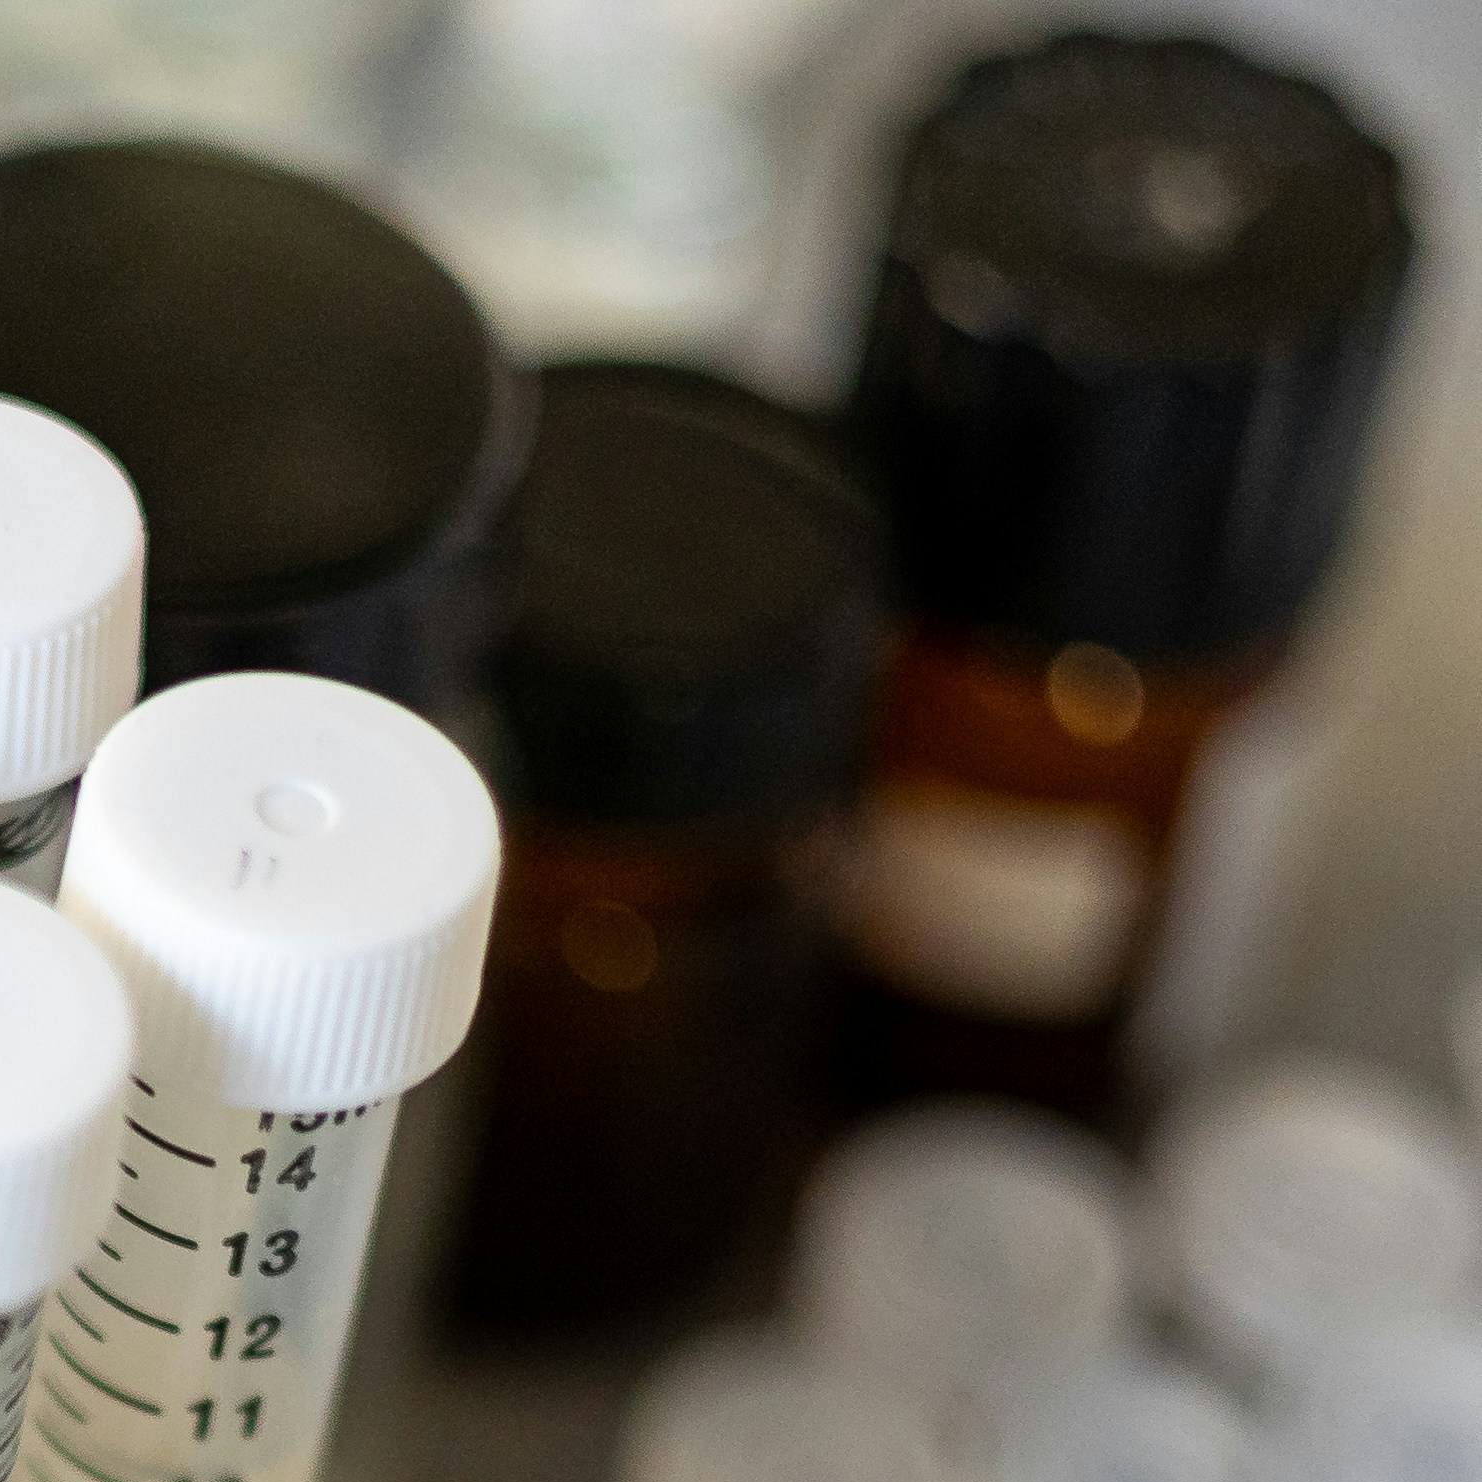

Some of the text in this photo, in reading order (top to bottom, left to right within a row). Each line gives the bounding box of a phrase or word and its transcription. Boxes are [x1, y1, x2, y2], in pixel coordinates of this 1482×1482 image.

[240, 1144, 318, 1194] 14
[221, 1229, 301, 1278] 13
[202, 1314, 283, 1361] 12
[187, 1396, 265, 1440] 11
